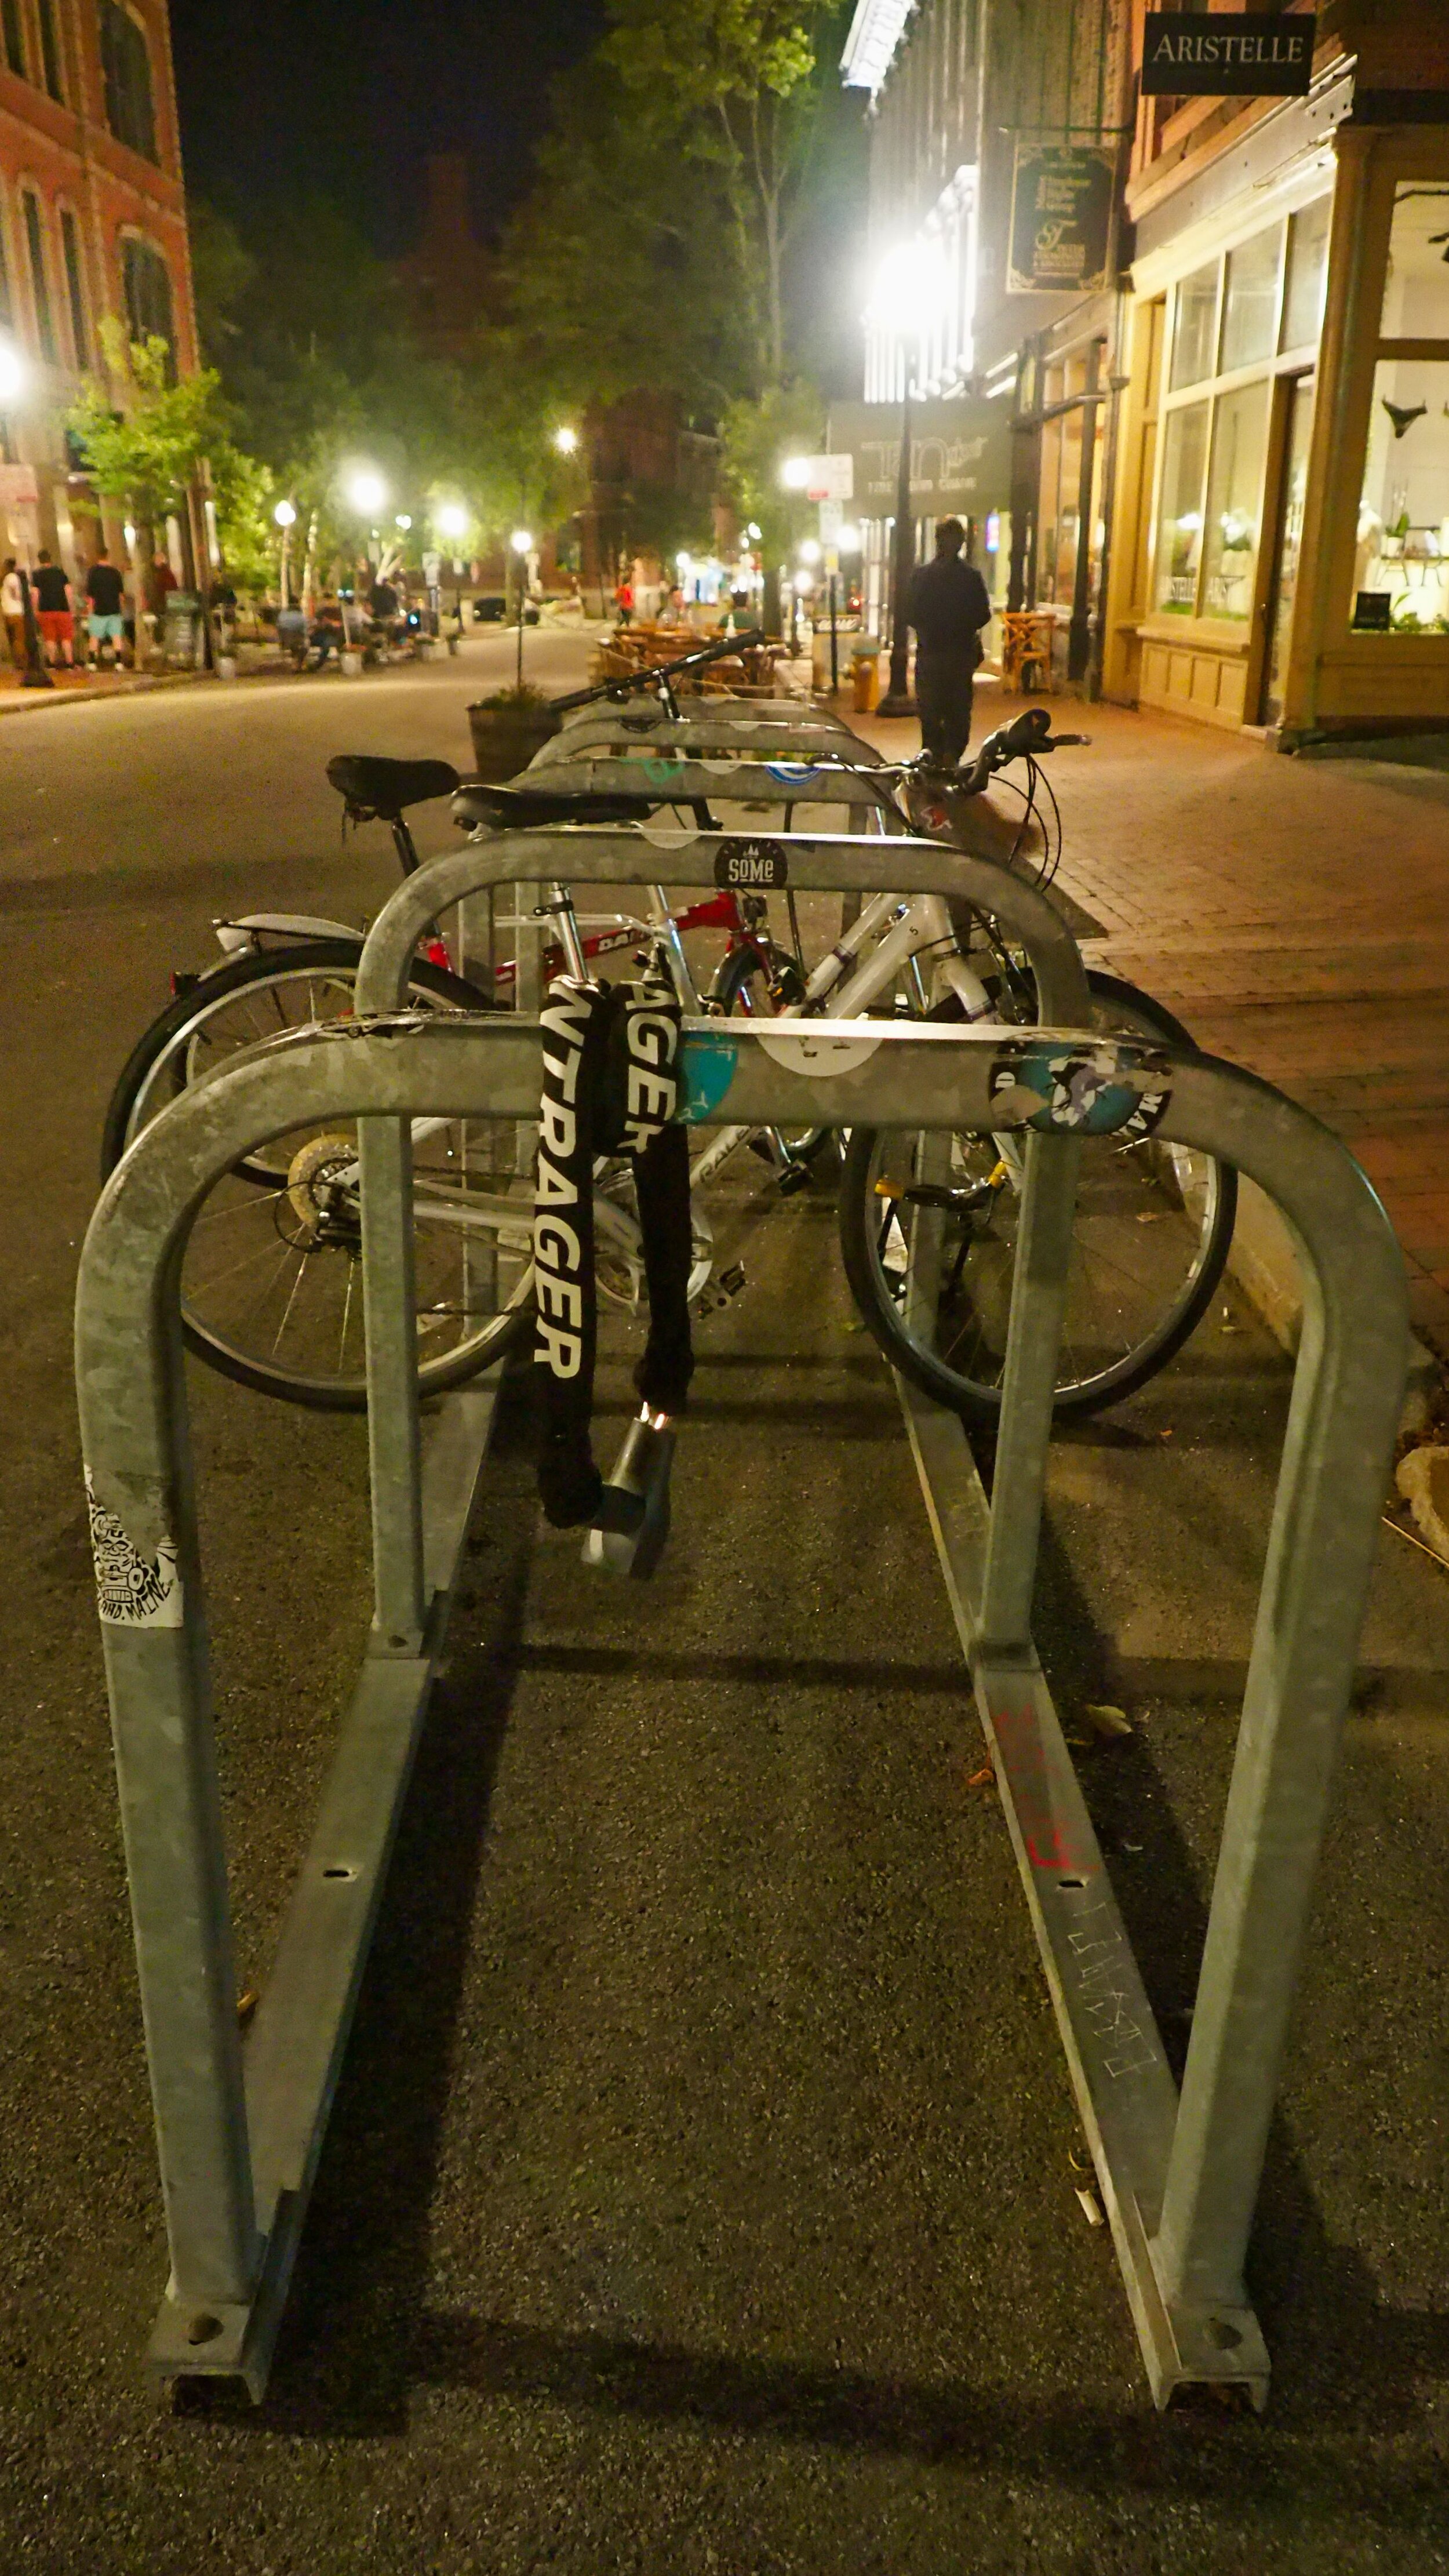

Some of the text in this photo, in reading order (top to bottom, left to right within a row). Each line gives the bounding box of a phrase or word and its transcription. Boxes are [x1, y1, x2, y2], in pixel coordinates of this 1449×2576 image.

[1153, 34, 1304, 63] ARISTELLE
[909, 926, 918, 936] 5
[125, 1573, 172, 1622] MAINE
